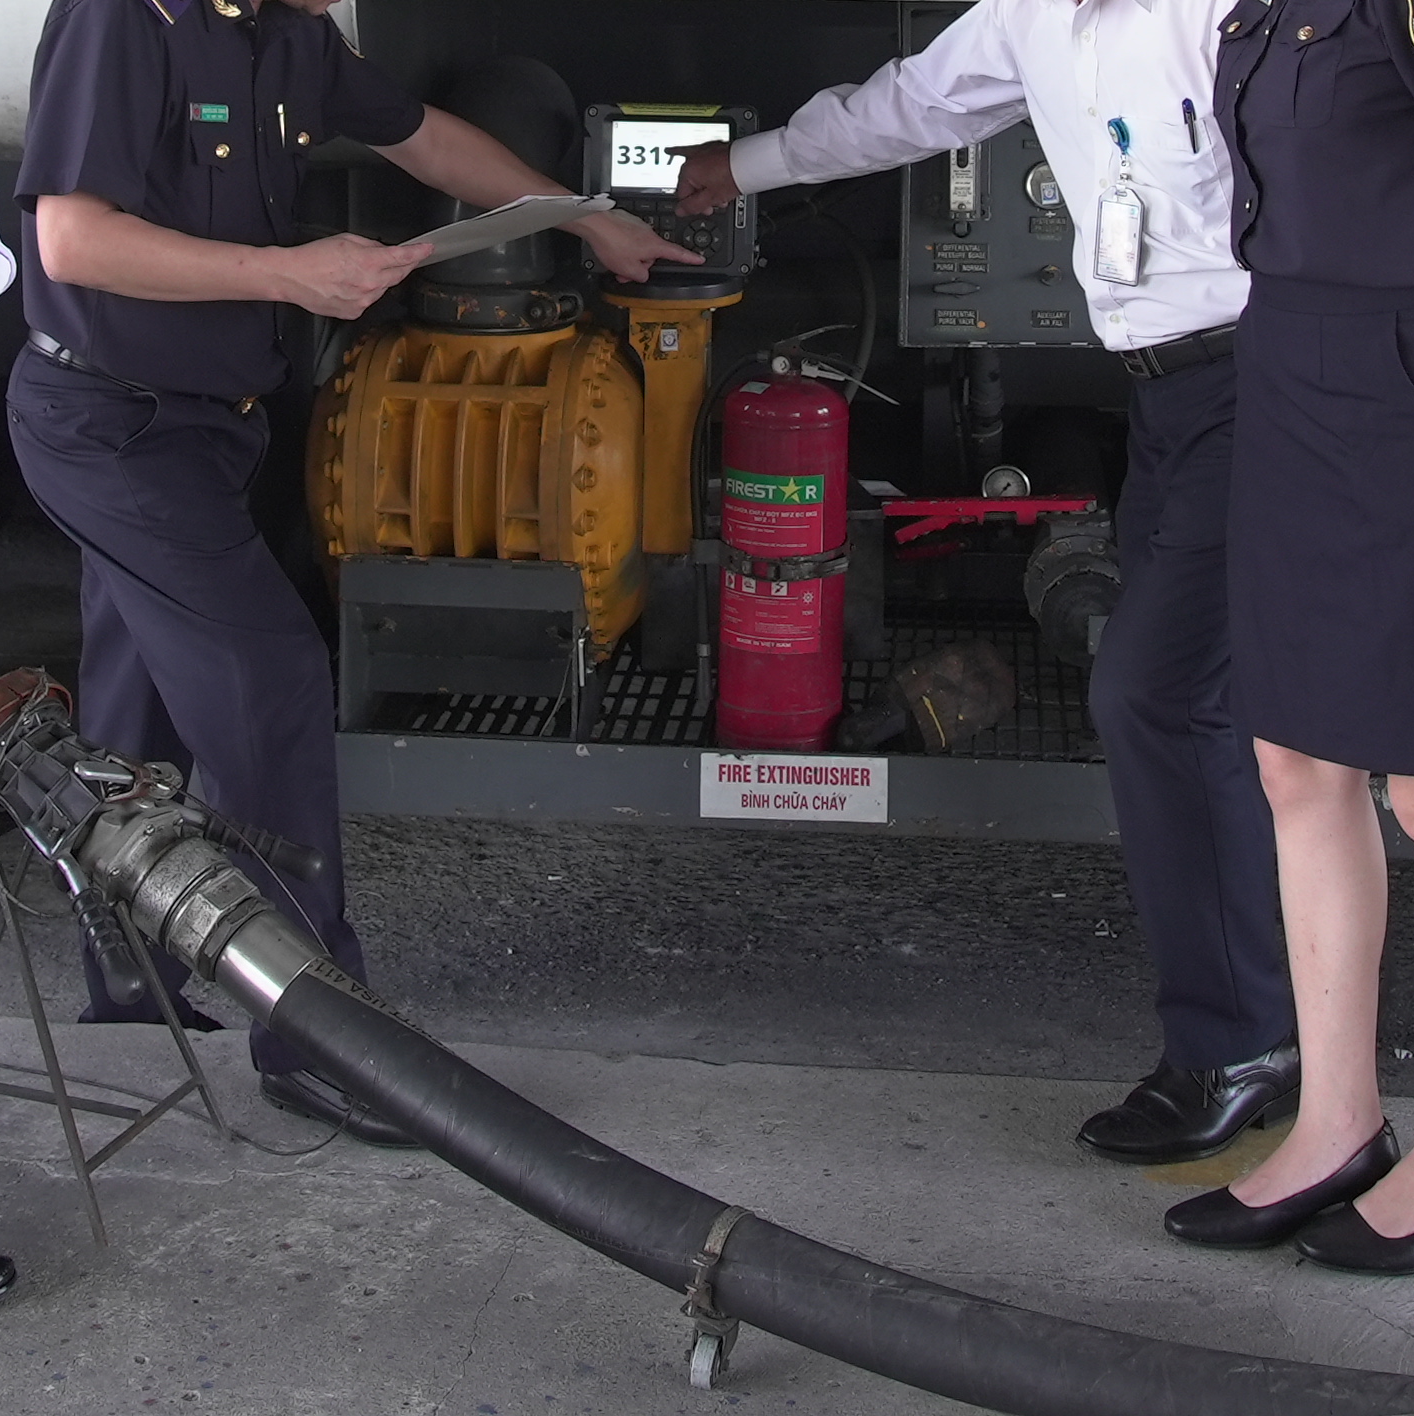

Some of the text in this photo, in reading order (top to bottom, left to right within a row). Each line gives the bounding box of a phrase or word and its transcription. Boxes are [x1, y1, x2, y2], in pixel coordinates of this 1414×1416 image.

[718, 764, 871, 787] FIRE EXTINGUISHER
[741, 790, 848, 811] BÌNH CHỮA CHÁY
